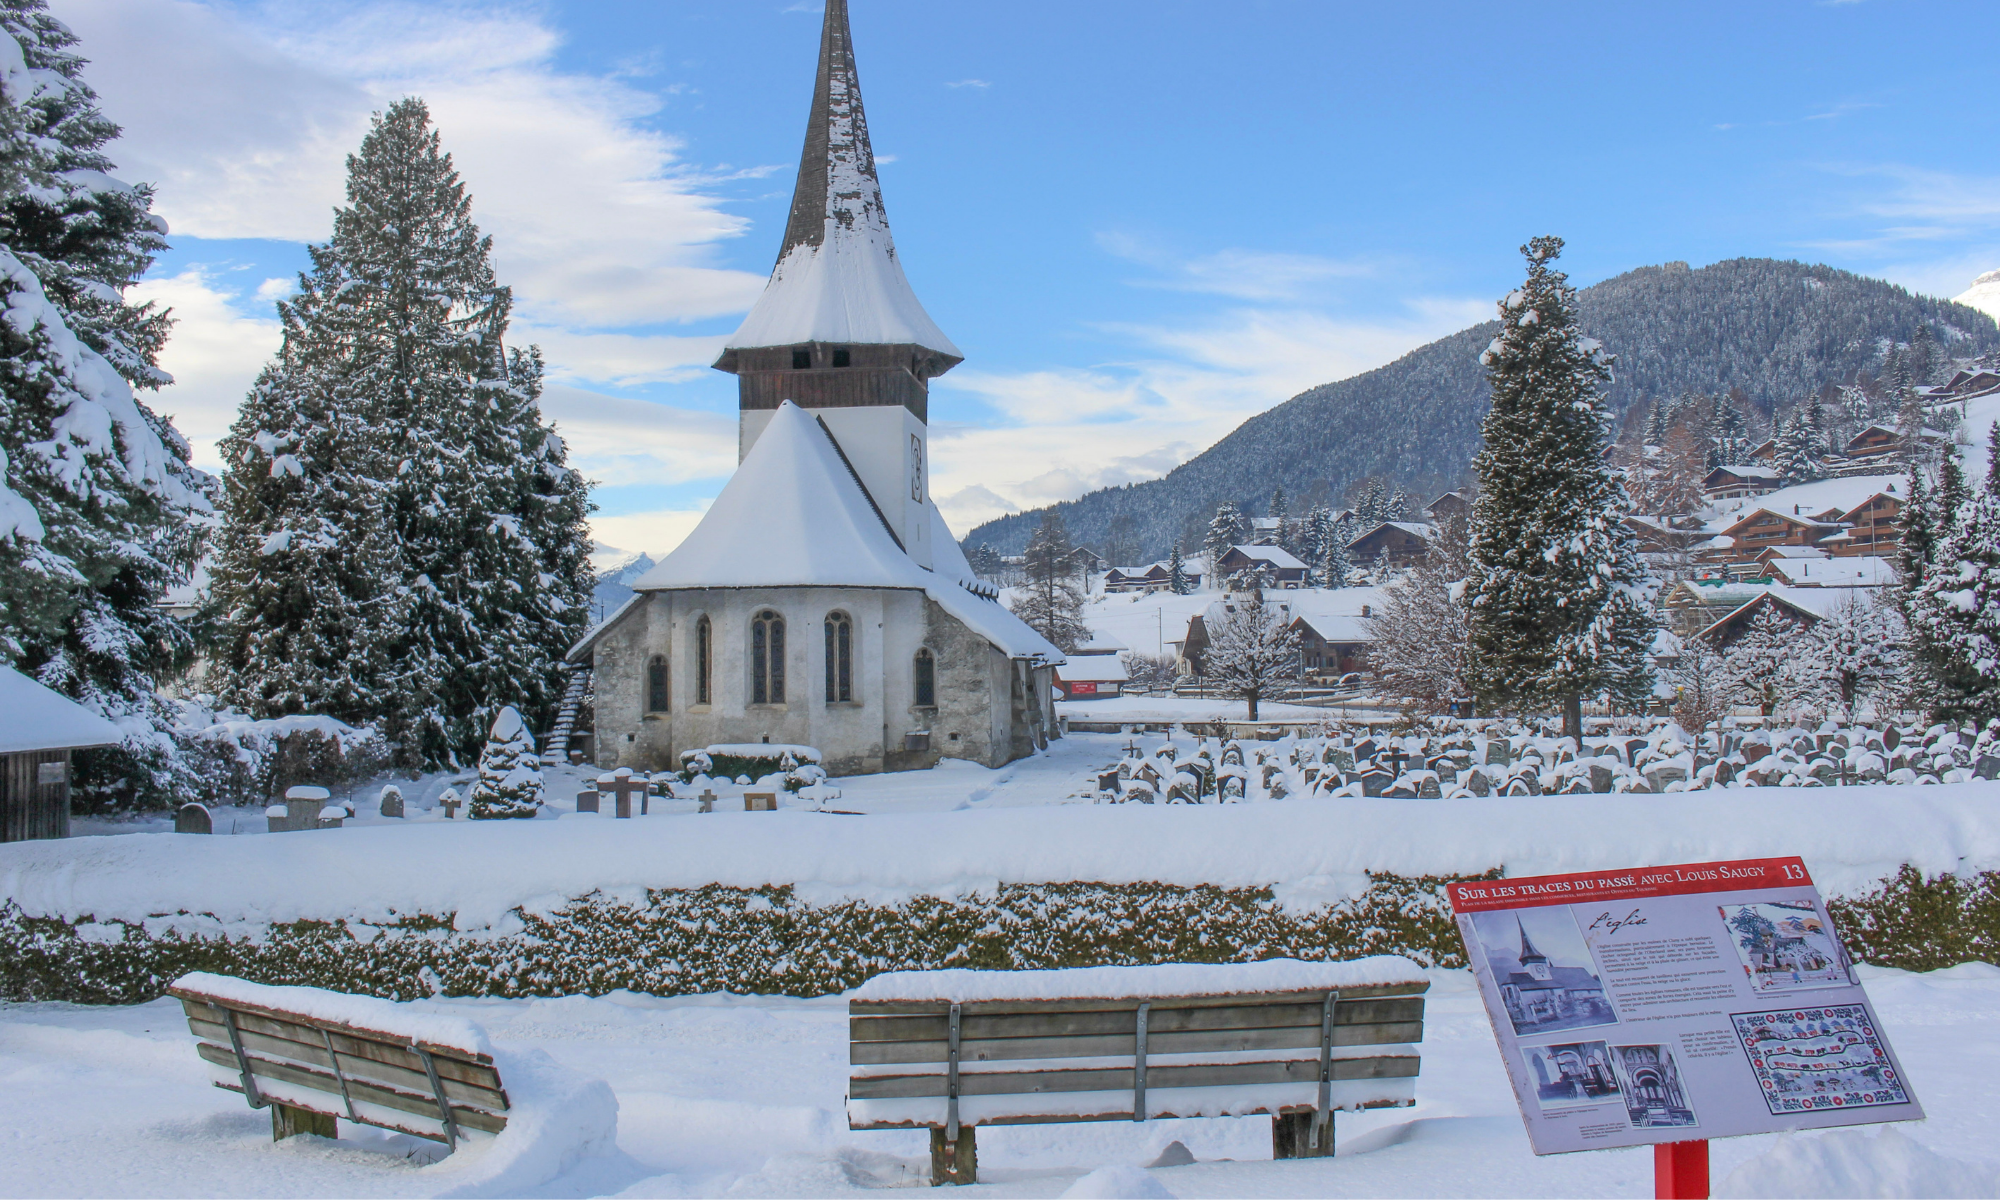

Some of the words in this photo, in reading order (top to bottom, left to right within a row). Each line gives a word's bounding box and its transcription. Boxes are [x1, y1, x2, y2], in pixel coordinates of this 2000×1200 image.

[1458, 887, 1488, 900] SUR
[1491, 887, 1516, 897] LES
[1518, 882, 1571, 894] TRACES
[1574, 880, 1594, 890] DU
[1597, 874, 1636, 888] PASSÉ
[1641, 874, 1673, 885] AVEC
[1674, 868, 1718, 881] LOUIS
[1719, 866, 1765, 878] SAUGY
[1782, 864, 1804, 879] 13
[1588, 908, 1648, 934] L'église
